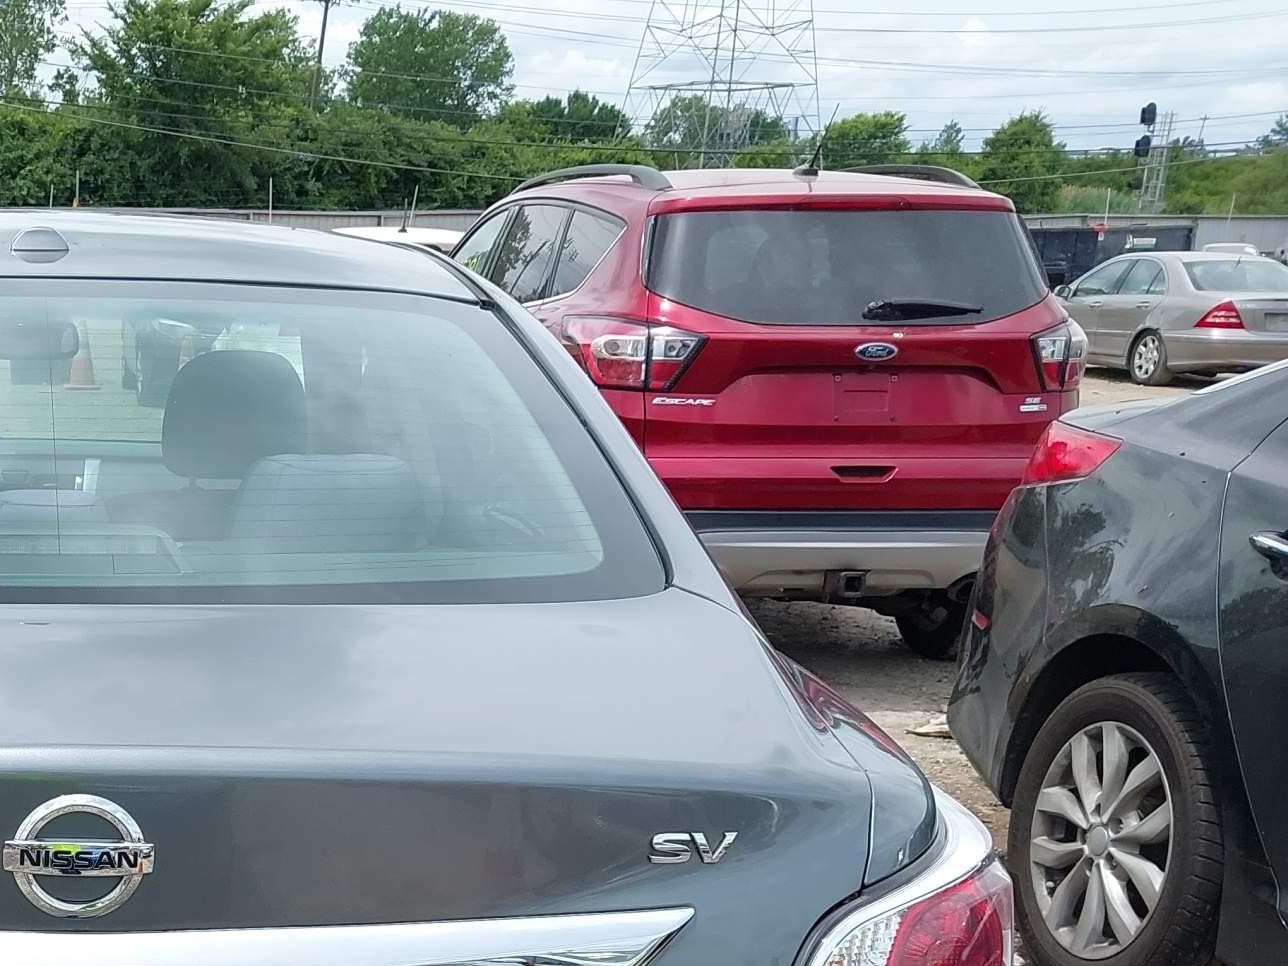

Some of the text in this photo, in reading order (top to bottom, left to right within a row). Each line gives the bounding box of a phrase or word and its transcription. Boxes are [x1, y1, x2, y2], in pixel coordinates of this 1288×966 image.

[652, 397, 716, 406] ESCAPE
[648, 832, 738, 864] SV
[19, 850, 139, 869] NISSAN
